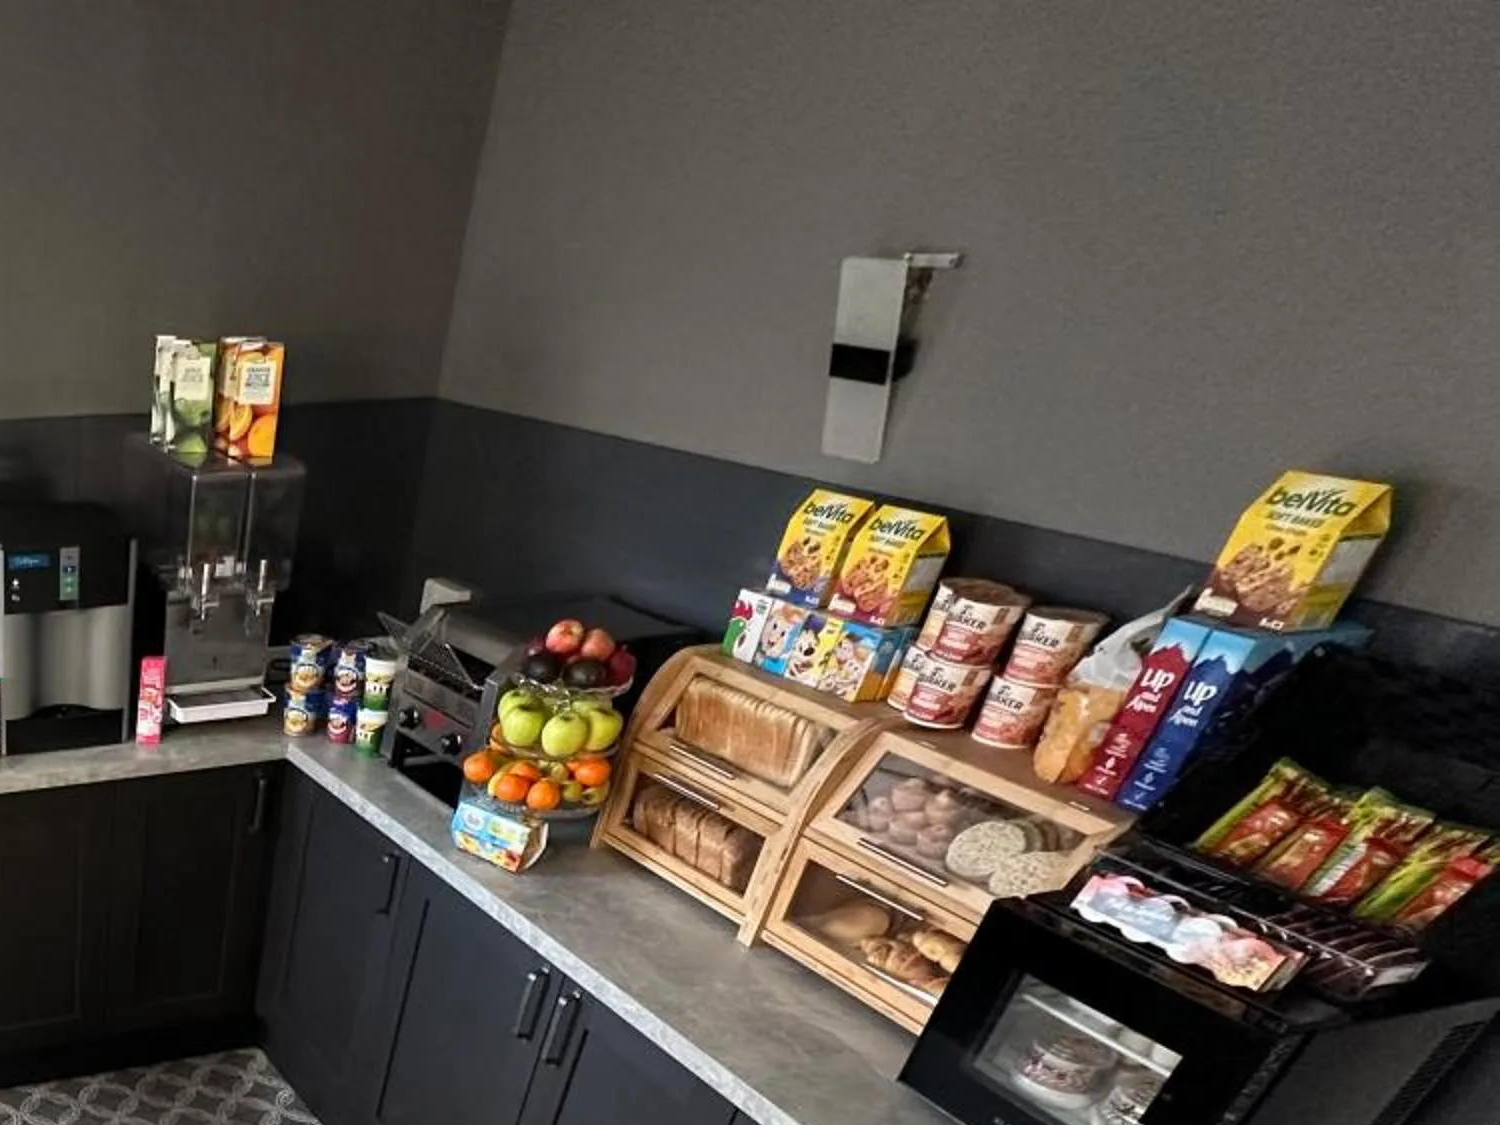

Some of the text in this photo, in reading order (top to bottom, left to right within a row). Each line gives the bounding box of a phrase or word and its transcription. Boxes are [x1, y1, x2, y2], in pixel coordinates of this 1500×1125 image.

[803, 501, 855, 524] belVita
[1266, 486, 1357, 516] belVita
[869, 516, 925, 541] belVita
